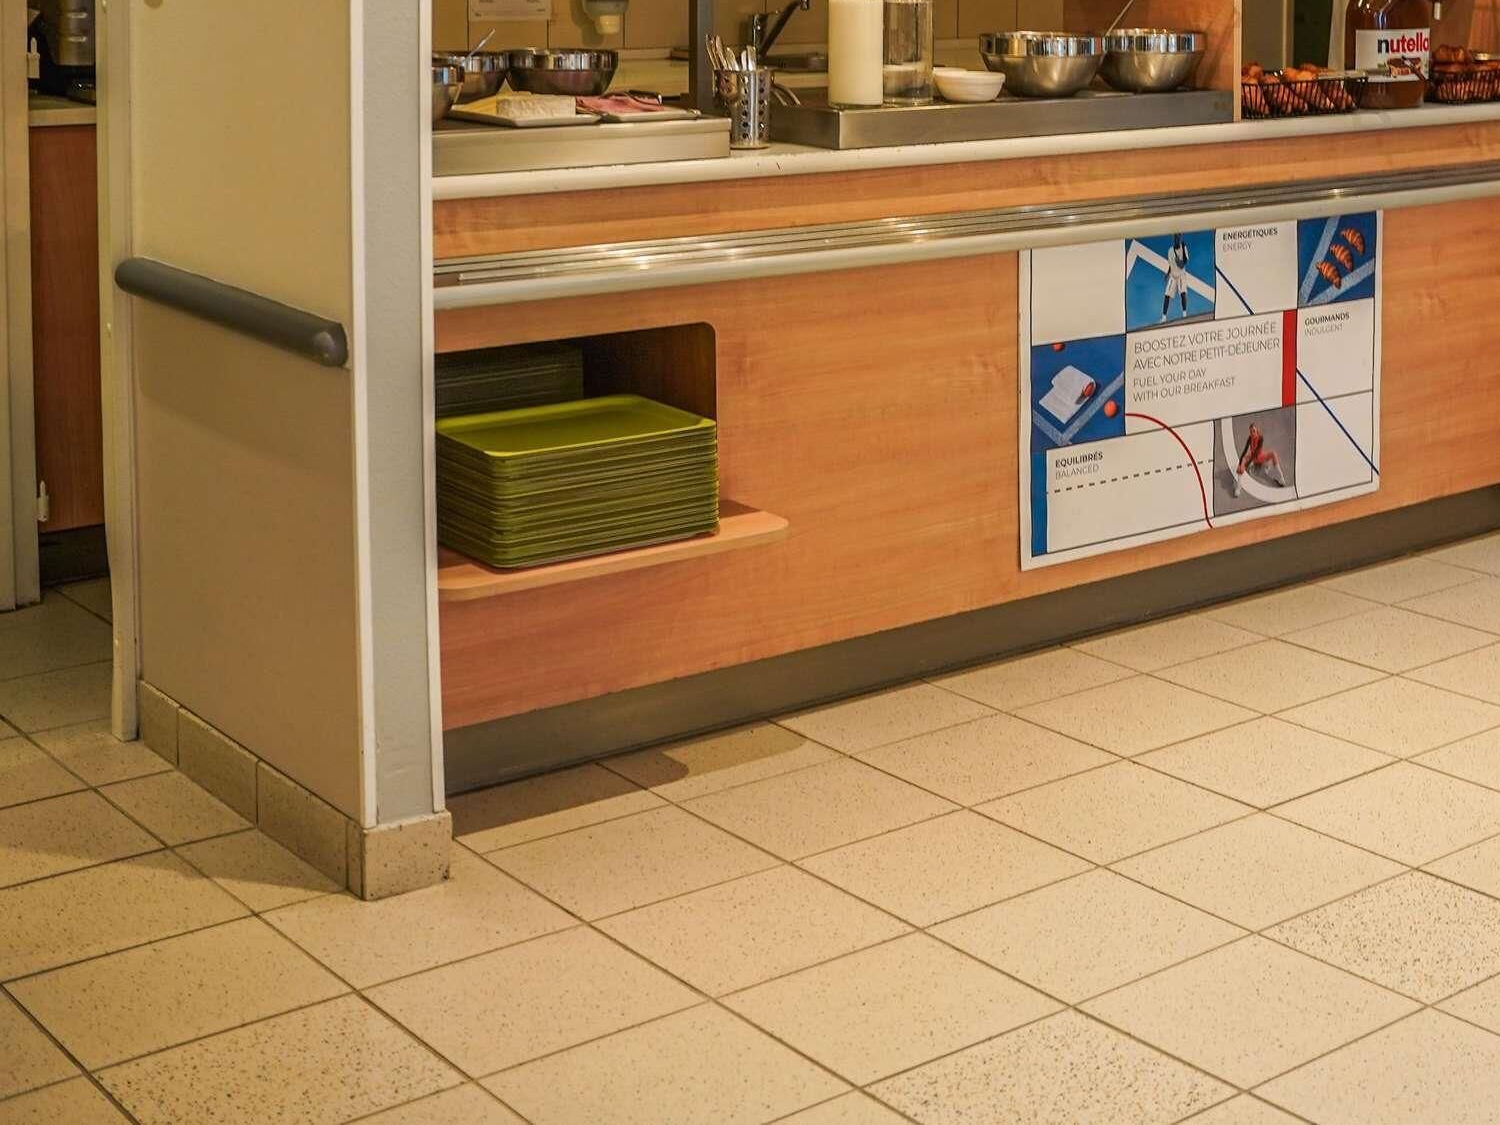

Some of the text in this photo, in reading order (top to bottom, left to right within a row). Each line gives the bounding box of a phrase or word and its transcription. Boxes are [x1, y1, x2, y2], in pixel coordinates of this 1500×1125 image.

[1377, 31, 1430, 54] nutella
[1222, 241, 1252, 253] ENERGY
[1304, 312, 1350, 326] GOURMANDS
[1134, 321, 1277, 354] BOOSTEZ VOTRE JOURNÉE
[1304, 323, 1343, 337] INDULGENT
[1133, 337, 1280, 371] AVEC NOTRE PETIT-DÉJEUNER
[1133, 367, 1207, 388] FUEL YOUR DAY
[1132, 376, 1236, 403] WITH OUR BREAKFAST
[1055, 463, 1100, 480] BALANCED
